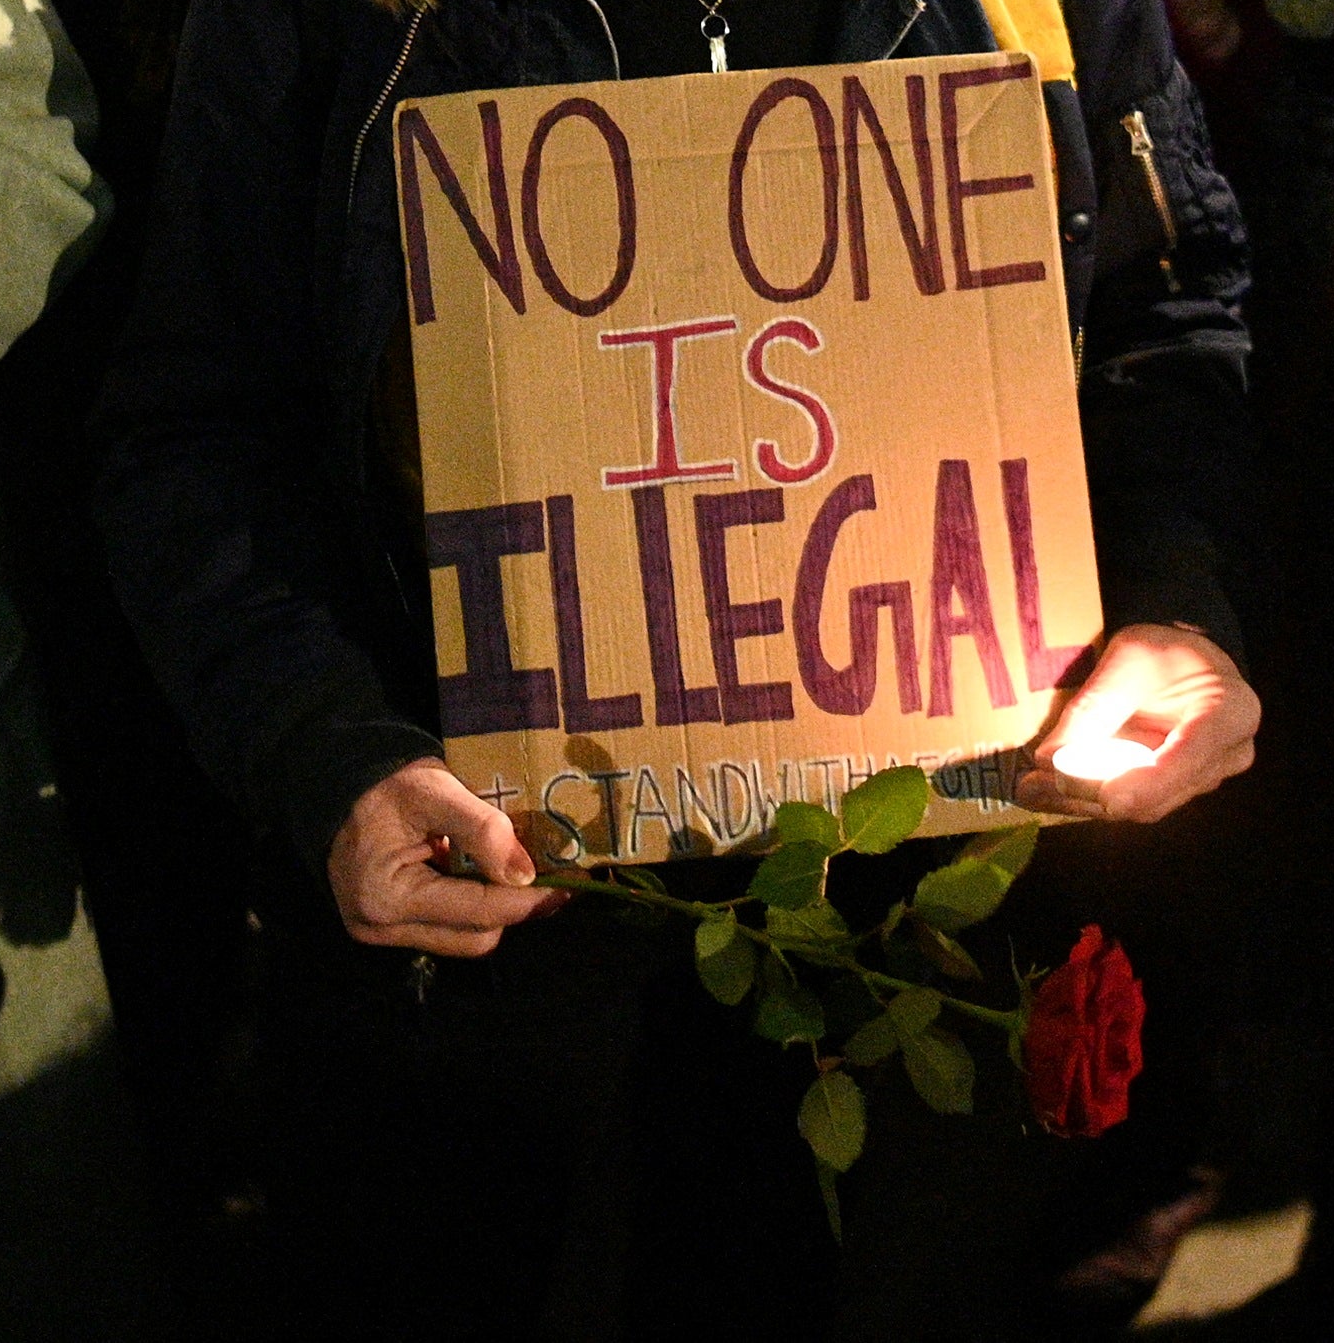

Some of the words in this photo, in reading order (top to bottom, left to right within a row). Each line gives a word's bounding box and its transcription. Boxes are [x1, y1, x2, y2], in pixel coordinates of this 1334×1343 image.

[398, 95, 638, 325] NO
[727, 61, 1047, 304] ONE
[598, 315, 840, 490] IS
[425, 457, 1095, 739] ILLEGAL
